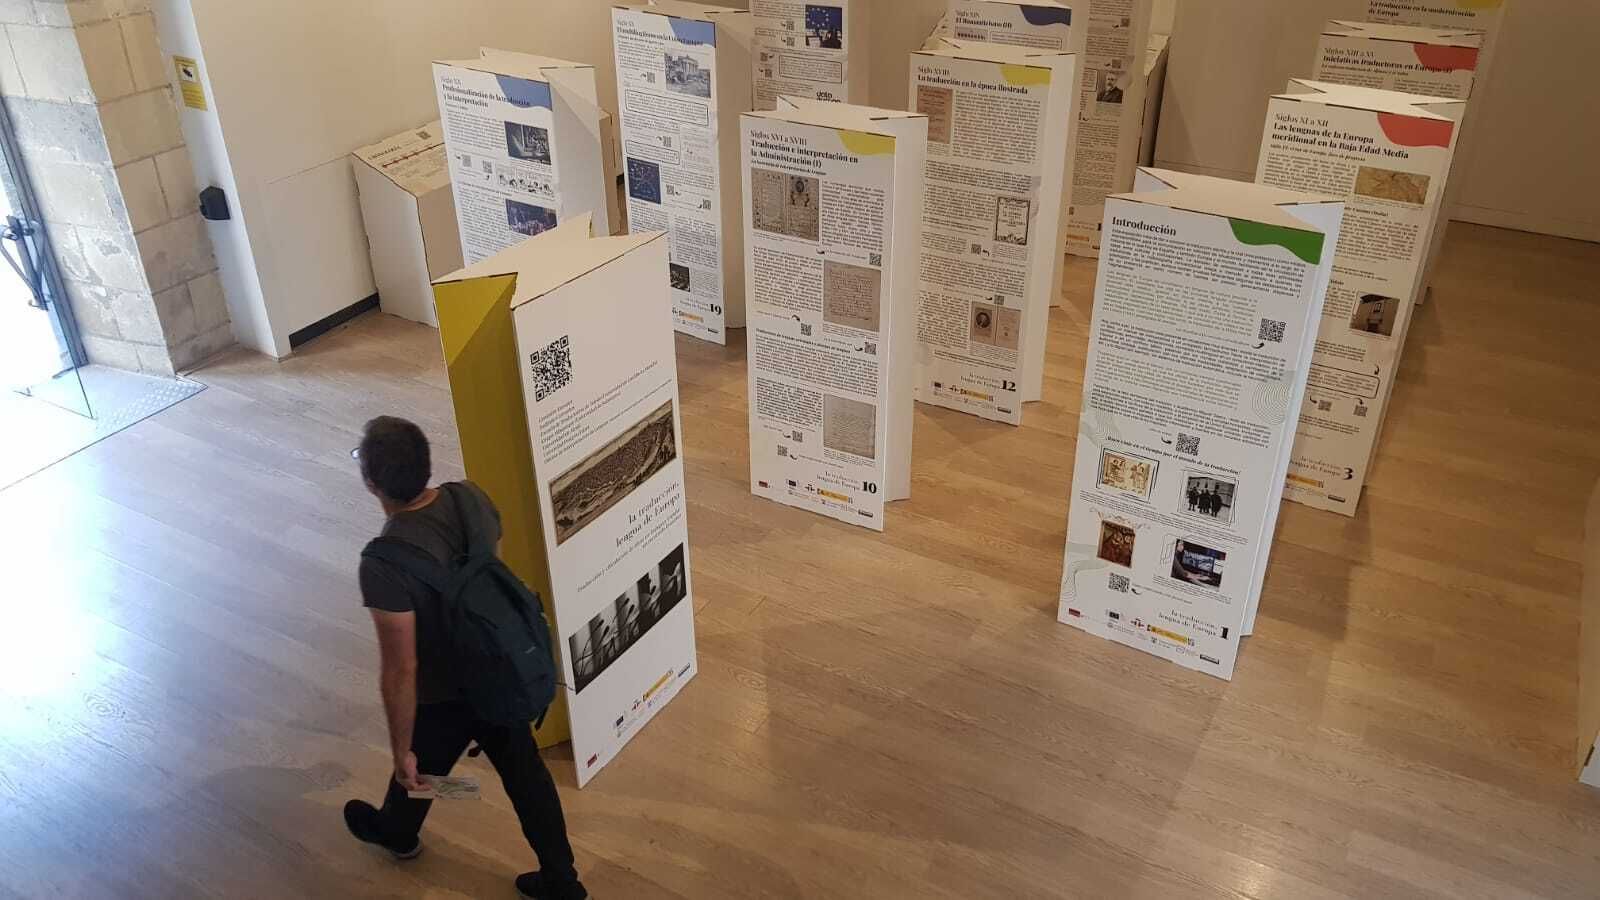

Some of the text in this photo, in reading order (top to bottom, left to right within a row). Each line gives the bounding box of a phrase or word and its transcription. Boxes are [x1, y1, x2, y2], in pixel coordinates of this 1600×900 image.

[978, 82, 997, 91] época
[1276, 114, 1298, 123] Siglos
[750, 130, 770, 140] Siglos
[1274, 122, 1374, 144] Las lenguas de la Europa
[751, 140, 790, 152] Traducción
[797, 147, 848, 162] interpretación
[850, 156, 858, 164] en
[1272, 133, 1316, 145] meridional
[1329, 140, 1337, 148] la
[1339, 142, 1357, 152] Baja
[1360, 144, 1380, 155] Edad
[1382, 147, 1409, 159] Media
[751, 148, 758, 157] la
[758, 150, 812, 165] Administración
[1112, 216, 1176, 236] Introducción
[710, 304, 722, 315] 19
[1000, 380, 1016, 392] 12
[1344, 467, 1353, 480] 3
[863, 481, 877, 494] 10
[616, 493, 680, 547] lengua de Europa
[629, 514, 636, 524] la
[1221, 626, 1229, 640] 1
